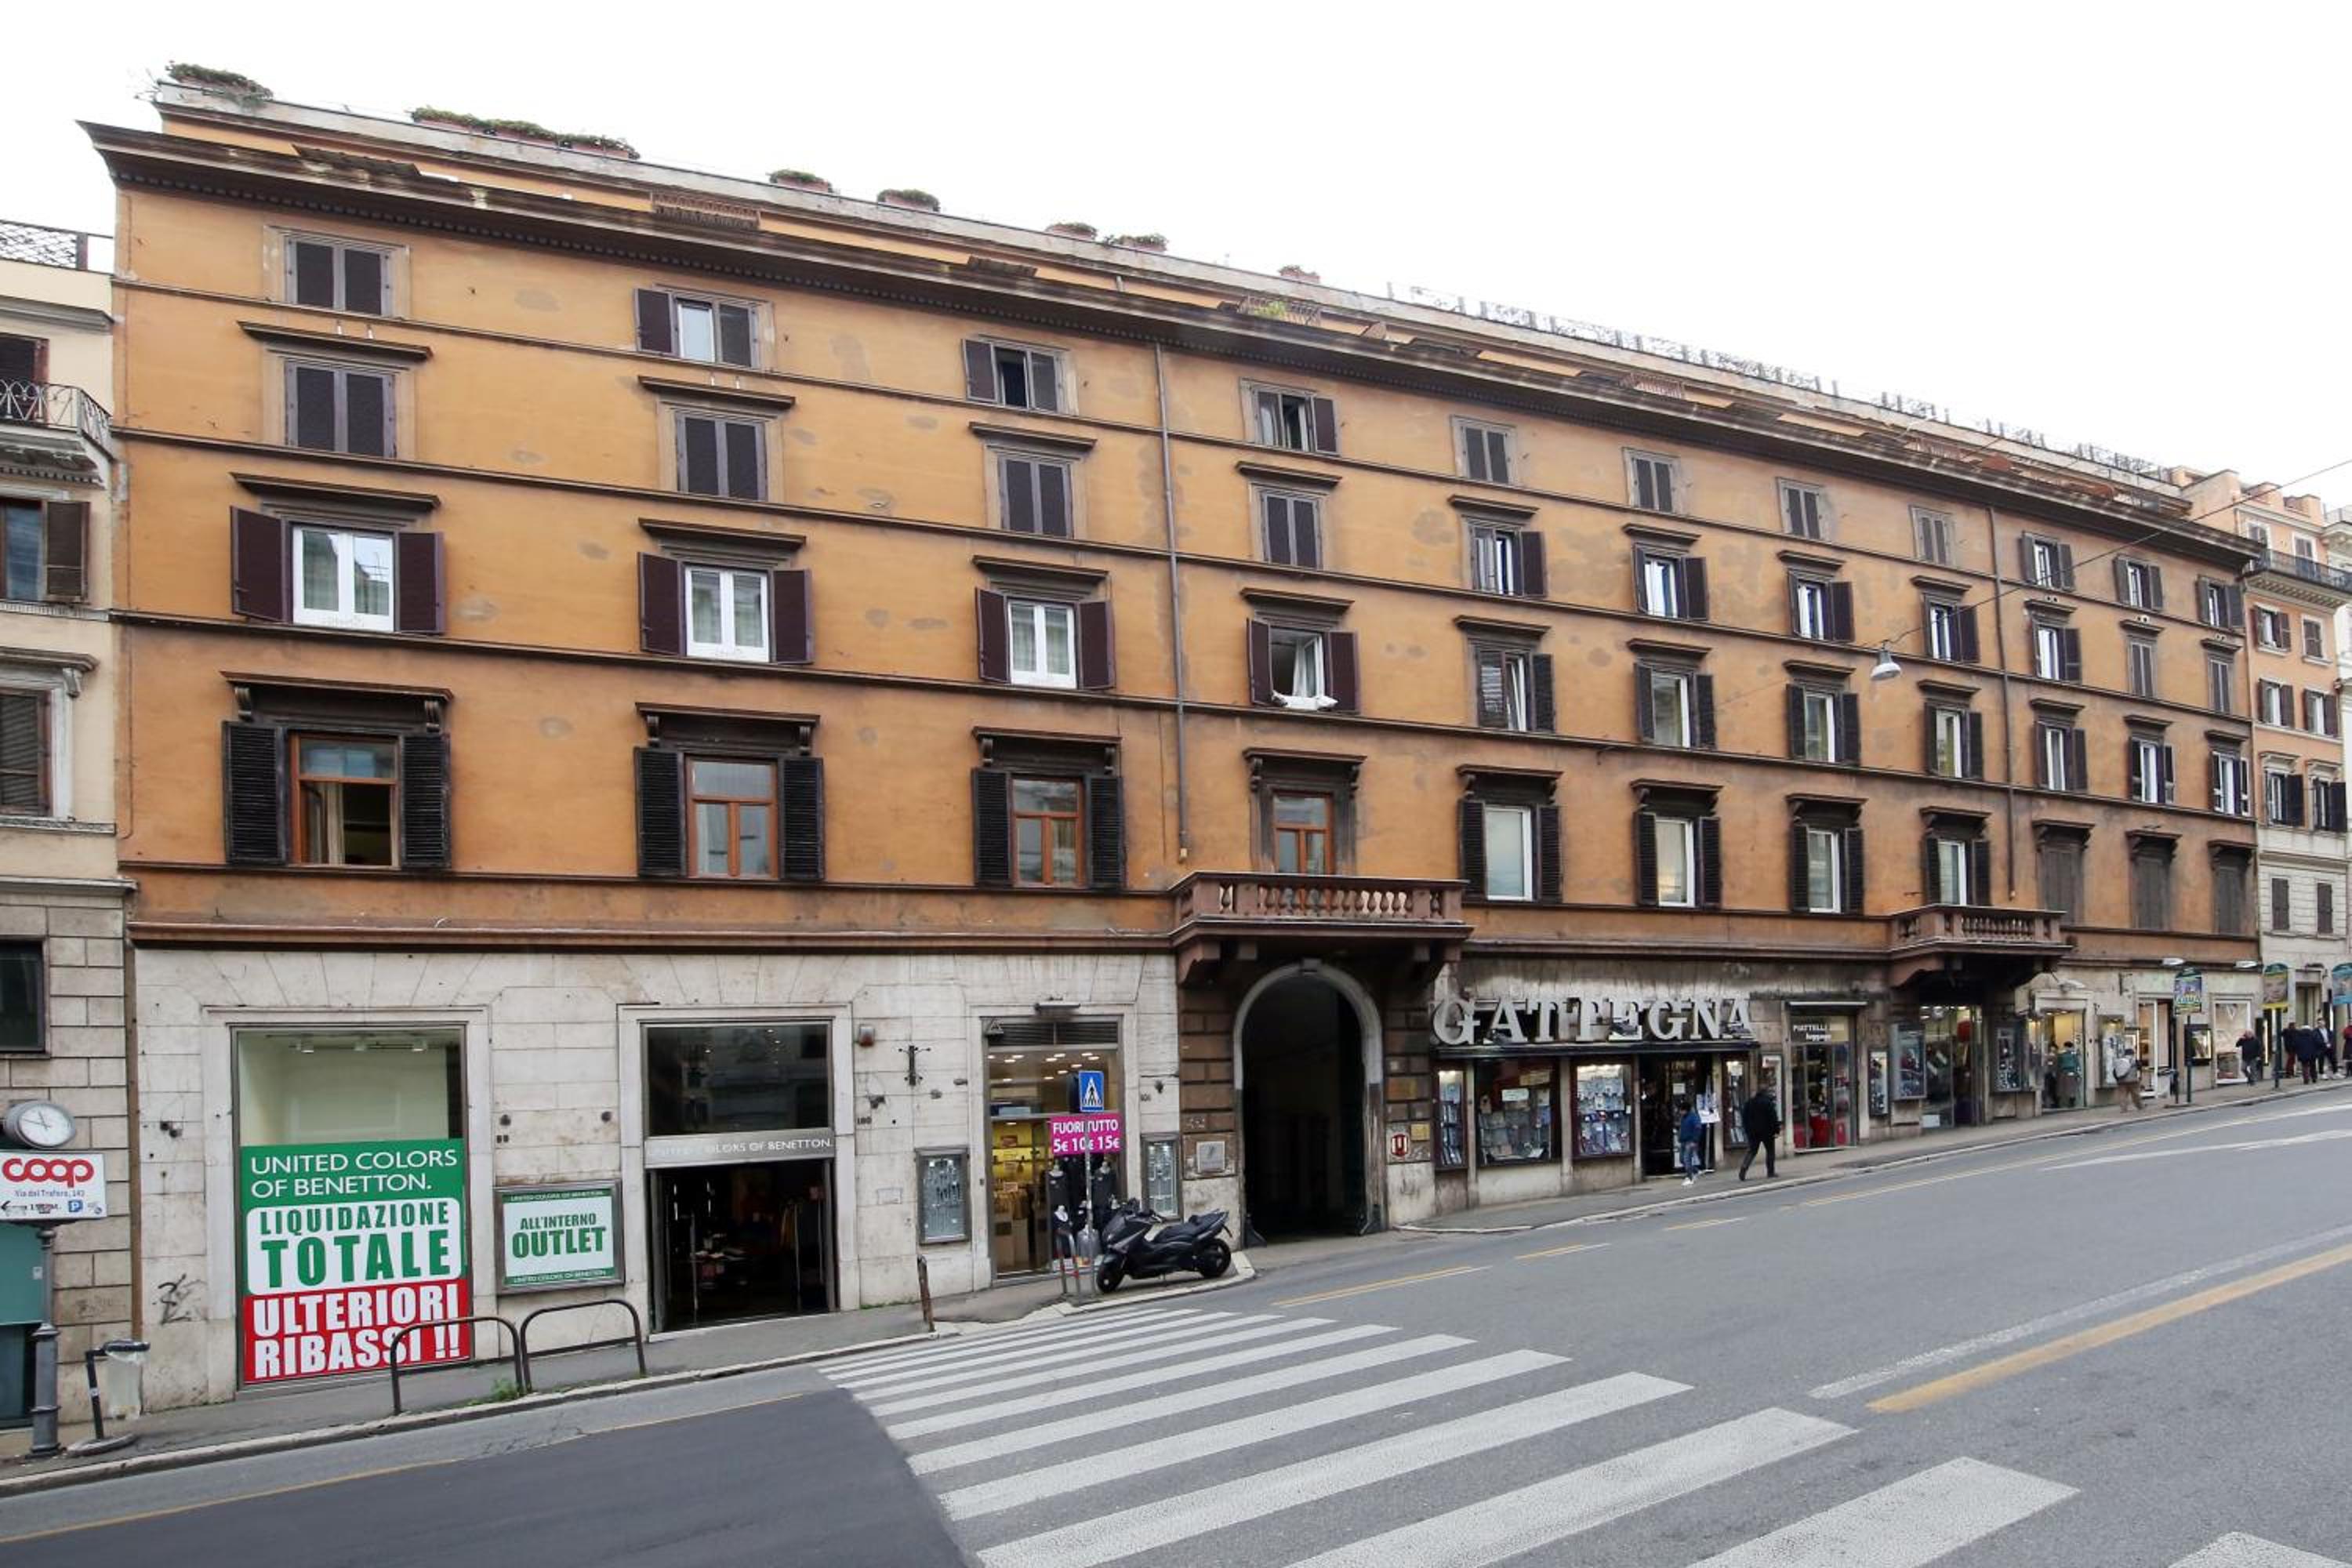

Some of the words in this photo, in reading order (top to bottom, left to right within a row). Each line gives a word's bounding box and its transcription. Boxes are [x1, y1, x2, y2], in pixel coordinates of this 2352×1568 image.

[1053, 1121, 1084, 1134] FUORI
[1087, 1119, 1119, 1133] TUTTO
[1053, 1138, 1069, 1153] 5€
[1098, 1134, 1120, 1149] 15€
[2, 1158, 94, 1188] coop
[251, 1153, 349, 1175] UNITED
[355, 1149, 458, 1171] COLORS
[251, 1179, 288, 1198] OF
[294, 1173, 432, 1197] BENETTON.
[260, 1202, 449, 1236] LIQUIDAZIONE
[521, 1213, 597, 1230] ALL'INTERNO
[512, 1226, 606, 1258] OUTLET
[260, 1229, 451, 1288] TOTALE
[253, 1283, 459, 1337] ULTERIORI
[255, 1326, 421, 1378] RIBASSI
